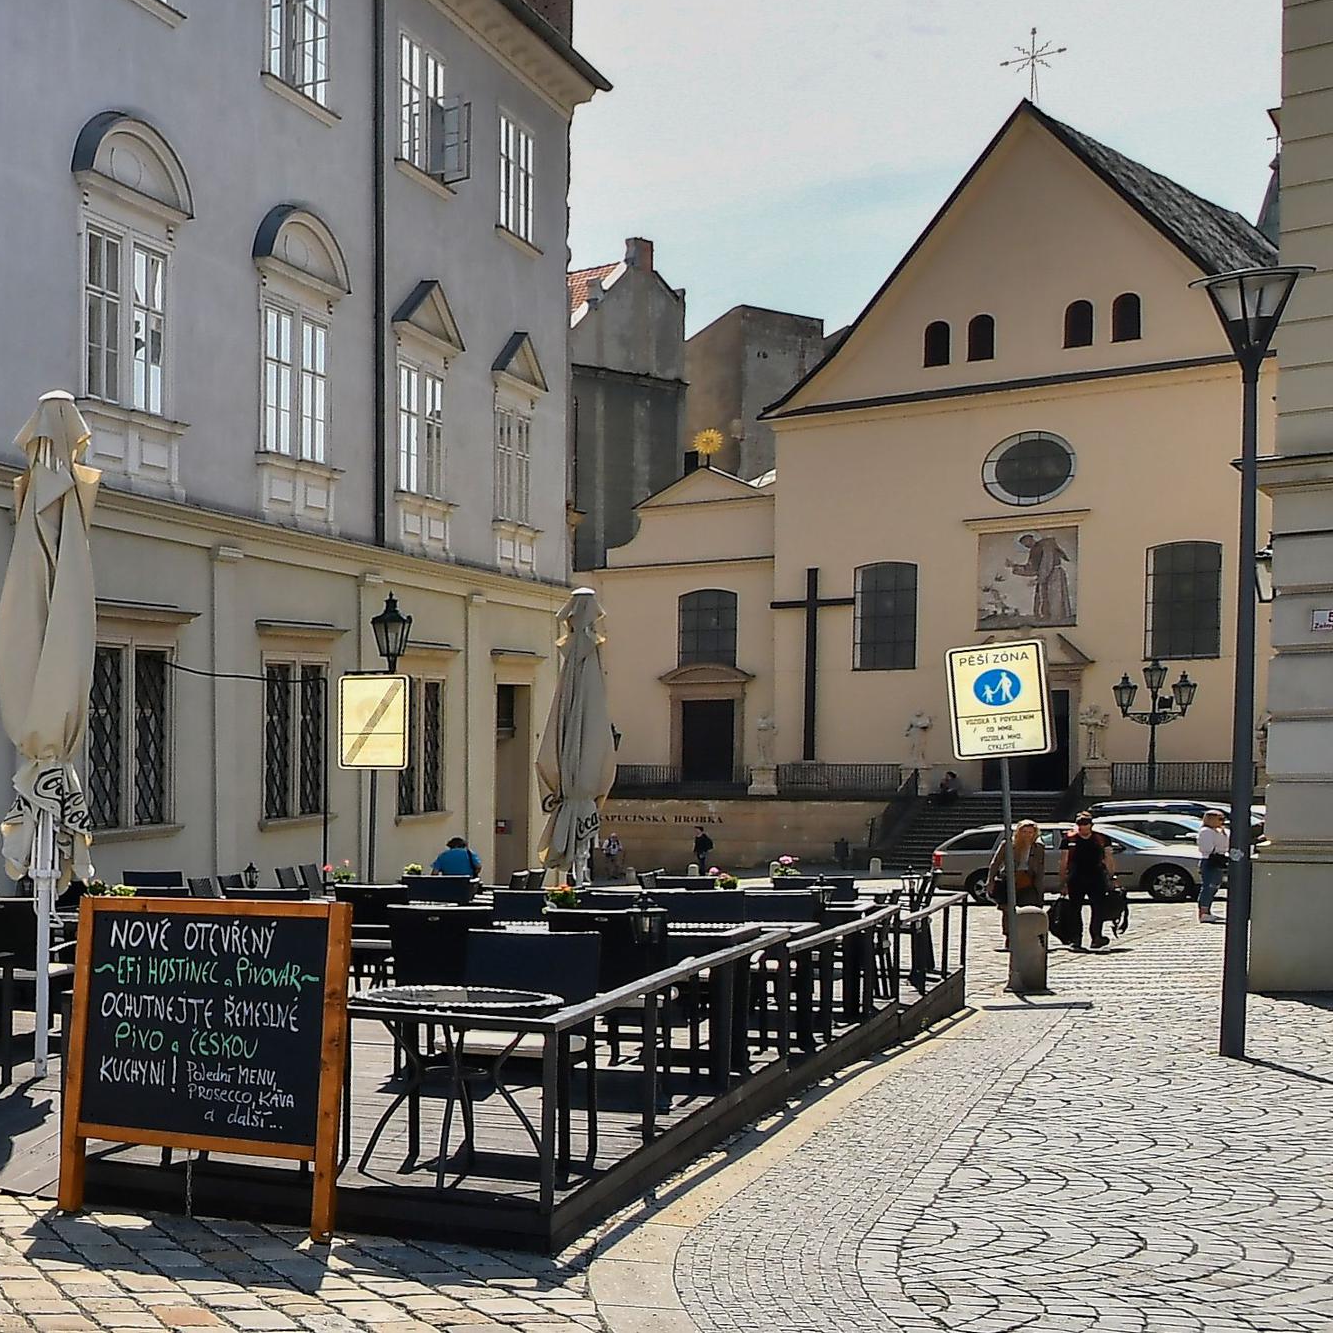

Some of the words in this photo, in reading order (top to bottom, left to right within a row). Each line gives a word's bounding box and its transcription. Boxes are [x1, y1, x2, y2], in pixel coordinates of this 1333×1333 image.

[959, 654, 989, 667] PĚŠÍ
[993, 651, 1029, 664] ZÓNA
[101, 990, 213, 1029] OCHUTNEJTE
[189, 1028, 259, 1059] ČESKOU
[204, 1108, 214, 1122] a
